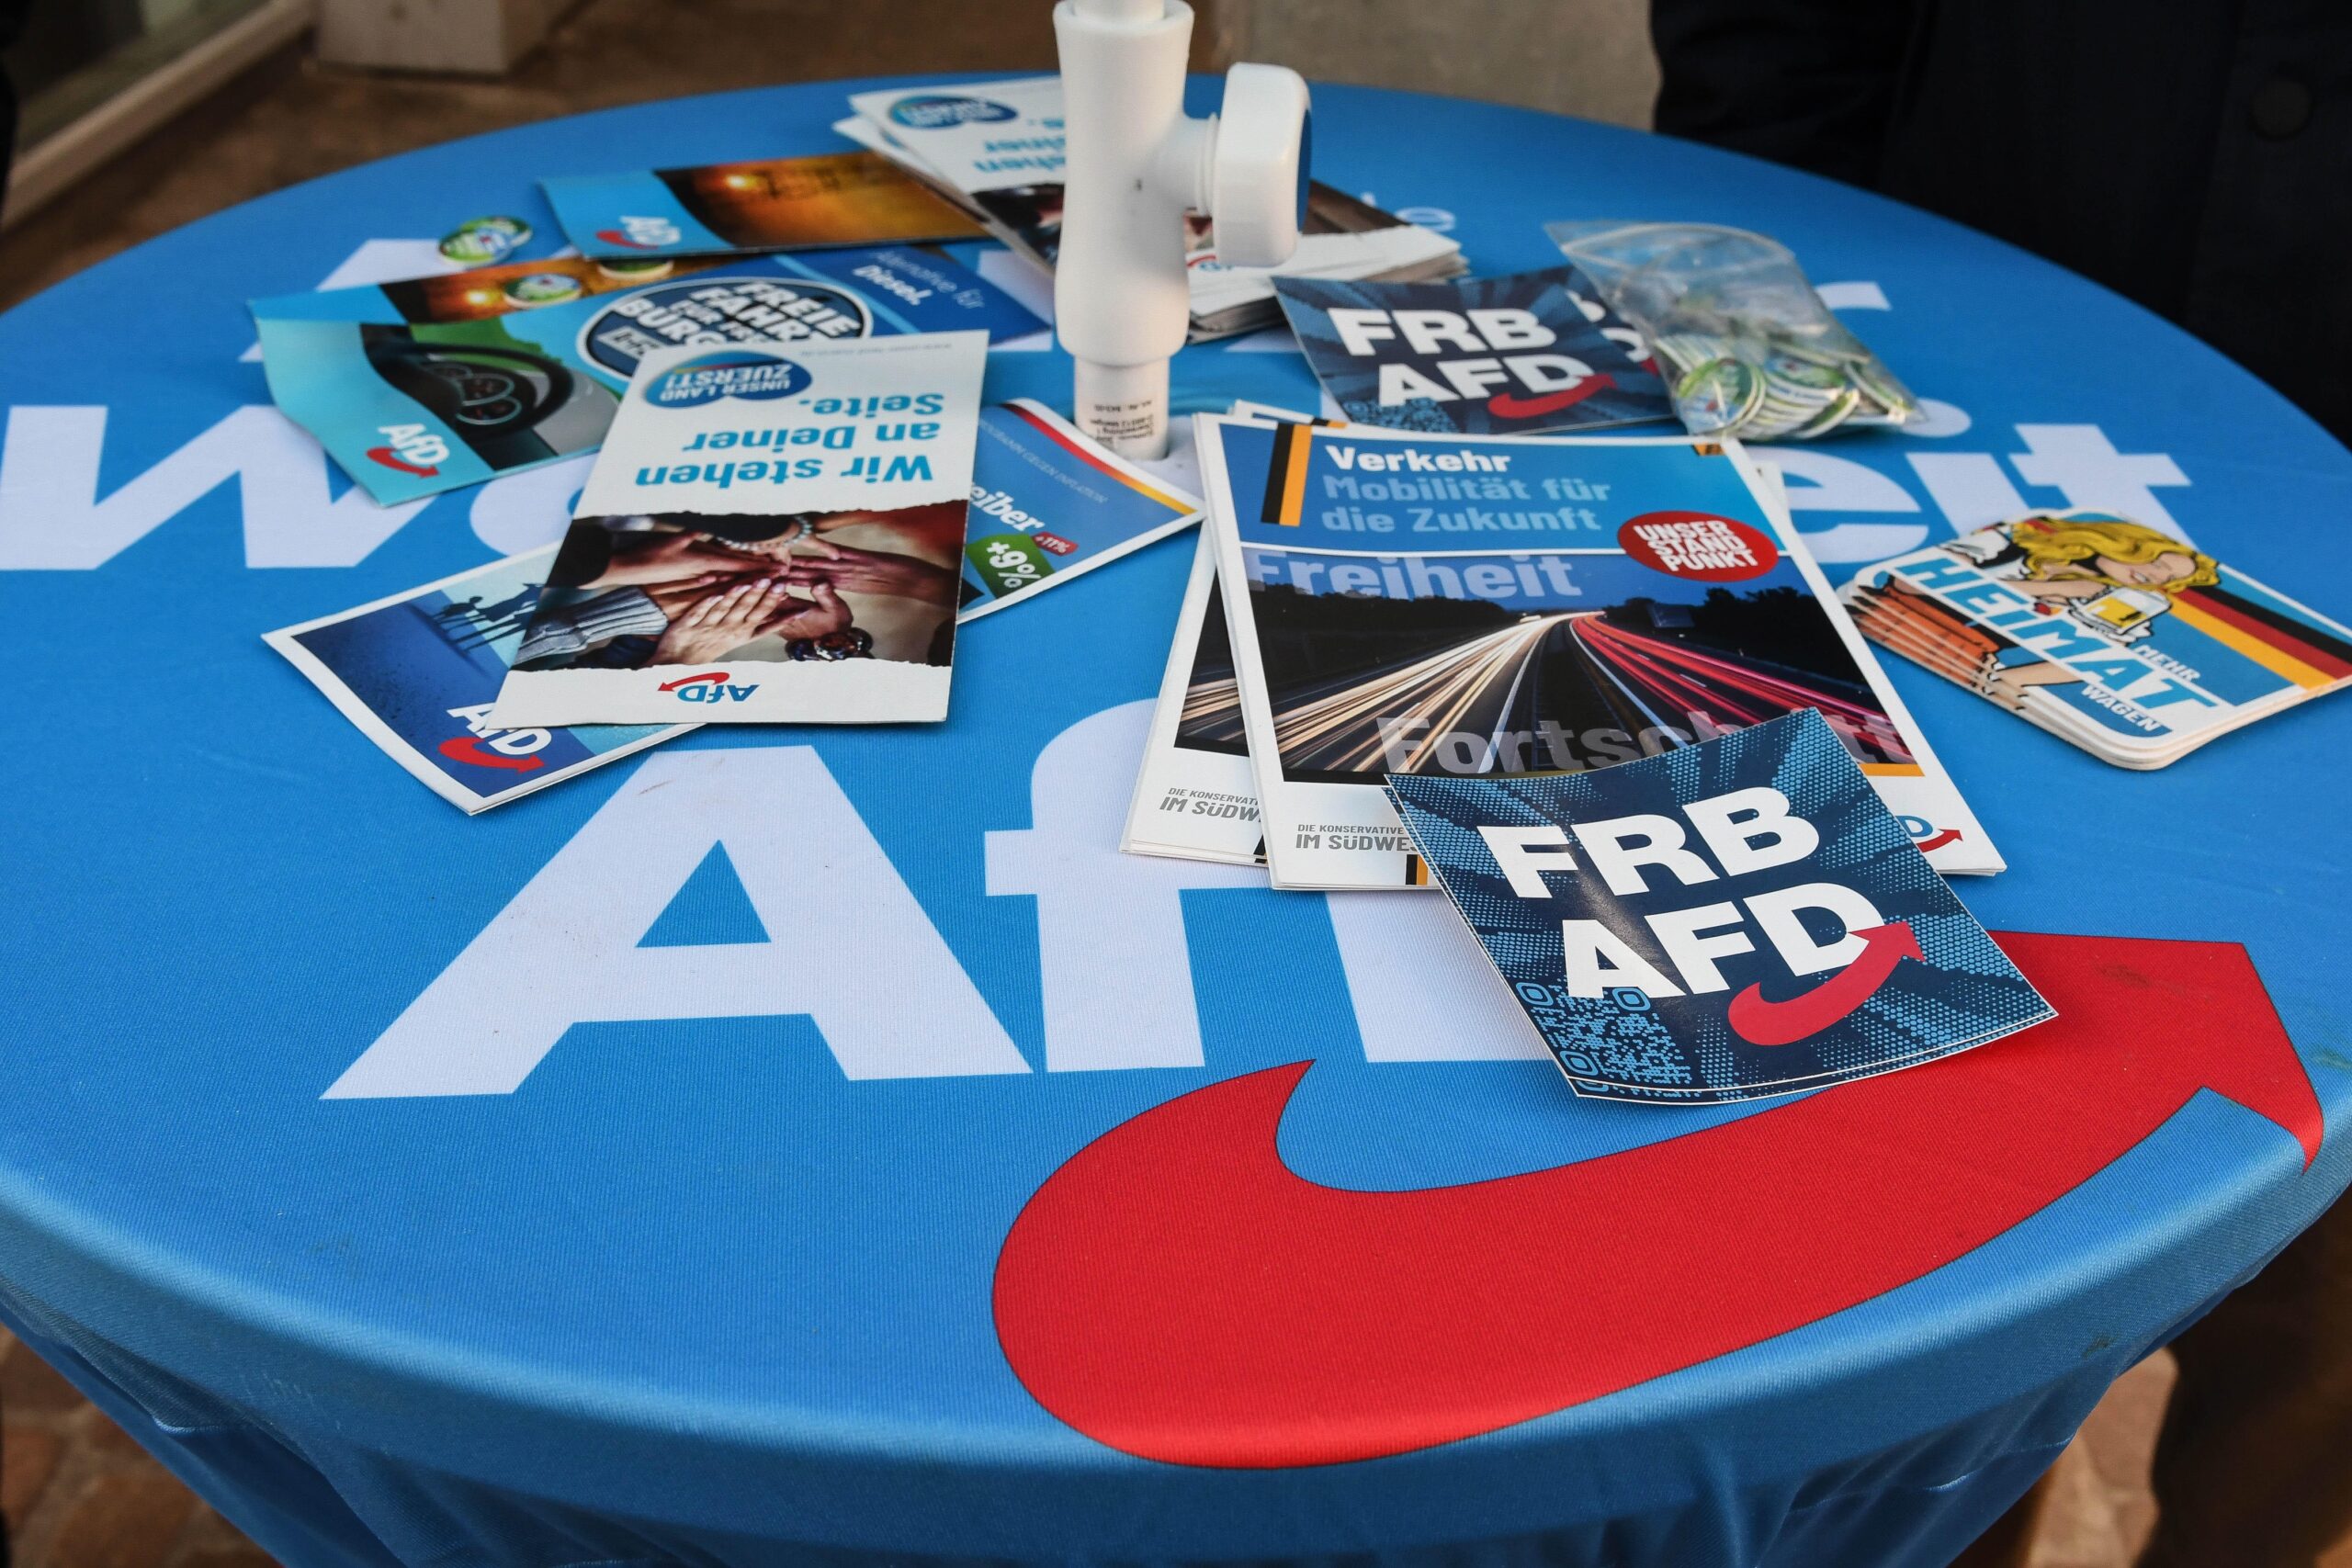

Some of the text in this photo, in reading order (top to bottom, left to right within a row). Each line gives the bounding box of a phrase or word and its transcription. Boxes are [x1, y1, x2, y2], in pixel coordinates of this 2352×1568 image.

[734, 281, 862, 336] FREIE
[1327, 307, 1557, 356] FRB
[659, 378, 792, 402] UNSER LAND
[666, 363, 794, 388] ZUERST!
[1378, 354, 1594, 407] AFD
[798, 393, 944, 418] Seite.
[377, 423, 450, 467] AfD
[682, 423, 943, 453] an Deiner
[635, 454, 933, 489] Wir stehen
[1325, 445, 1511, 472] Verkehr
[1320, 474, 1611, 502] Mobilität für
[969, 481, 1046, 532] eiber
[1320, 506, 1602, 533] die Zukunft
[1633, 519, 1735, 542] UNSER
[1646, 535, 1747, 557] STAND
[1660, 549, 1759, 572] PUNKT
[986, 541, 1042, 589] +9%
[1242, 546, 1583, 600] Freiheit
[1894, 555, 2222, 712] HEIMAT
[2134, 643, 2202, 684] MEHR
[677, 683, 761, 705] AfD
[2079, 684, 2162, 734] WAGEN
[1159, 796, 1261, 823] IM SÜDW
[1168, 787, 1259, 807] DIE KONSERVATI
[1295, 834, 1320, 850] IM
[1297, 824, 1405, 835] DIE KONSERVATIVE
[1476, 785, 1819, 900] FRB
[1559, 882, 1886, 1001] AFD
